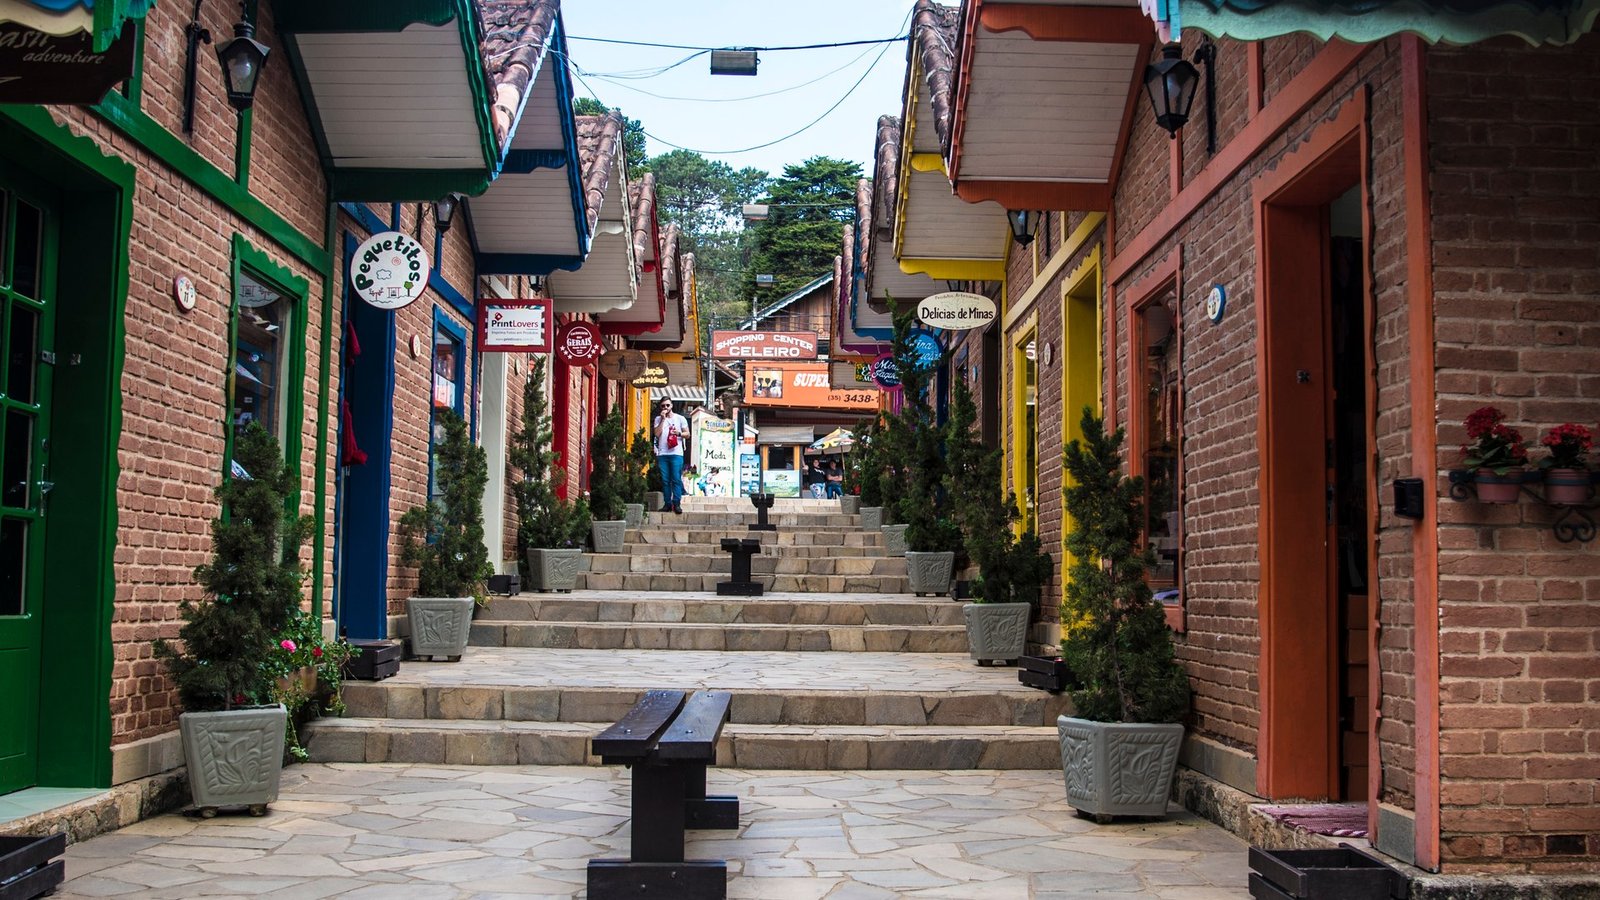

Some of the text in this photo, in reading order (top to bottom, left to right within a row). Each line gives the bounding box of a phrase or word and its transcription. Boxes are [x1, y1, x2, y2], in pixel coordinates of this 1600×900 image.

[22, 45, 105, 64] adventure
[355, 236, 420, 290] Pequetitos
[957, 308, 968, 319] de
[968, 307, 994, 319] Minas
[491, 320, 539, 328] PrintLovers
[566, 337, 592, 346] GERAIS
[716, 333, 813, 352] SHOPPING CENTER
[729, 346, 800, 357] CELEIRO
[705, 449, 727, 460] Moda
